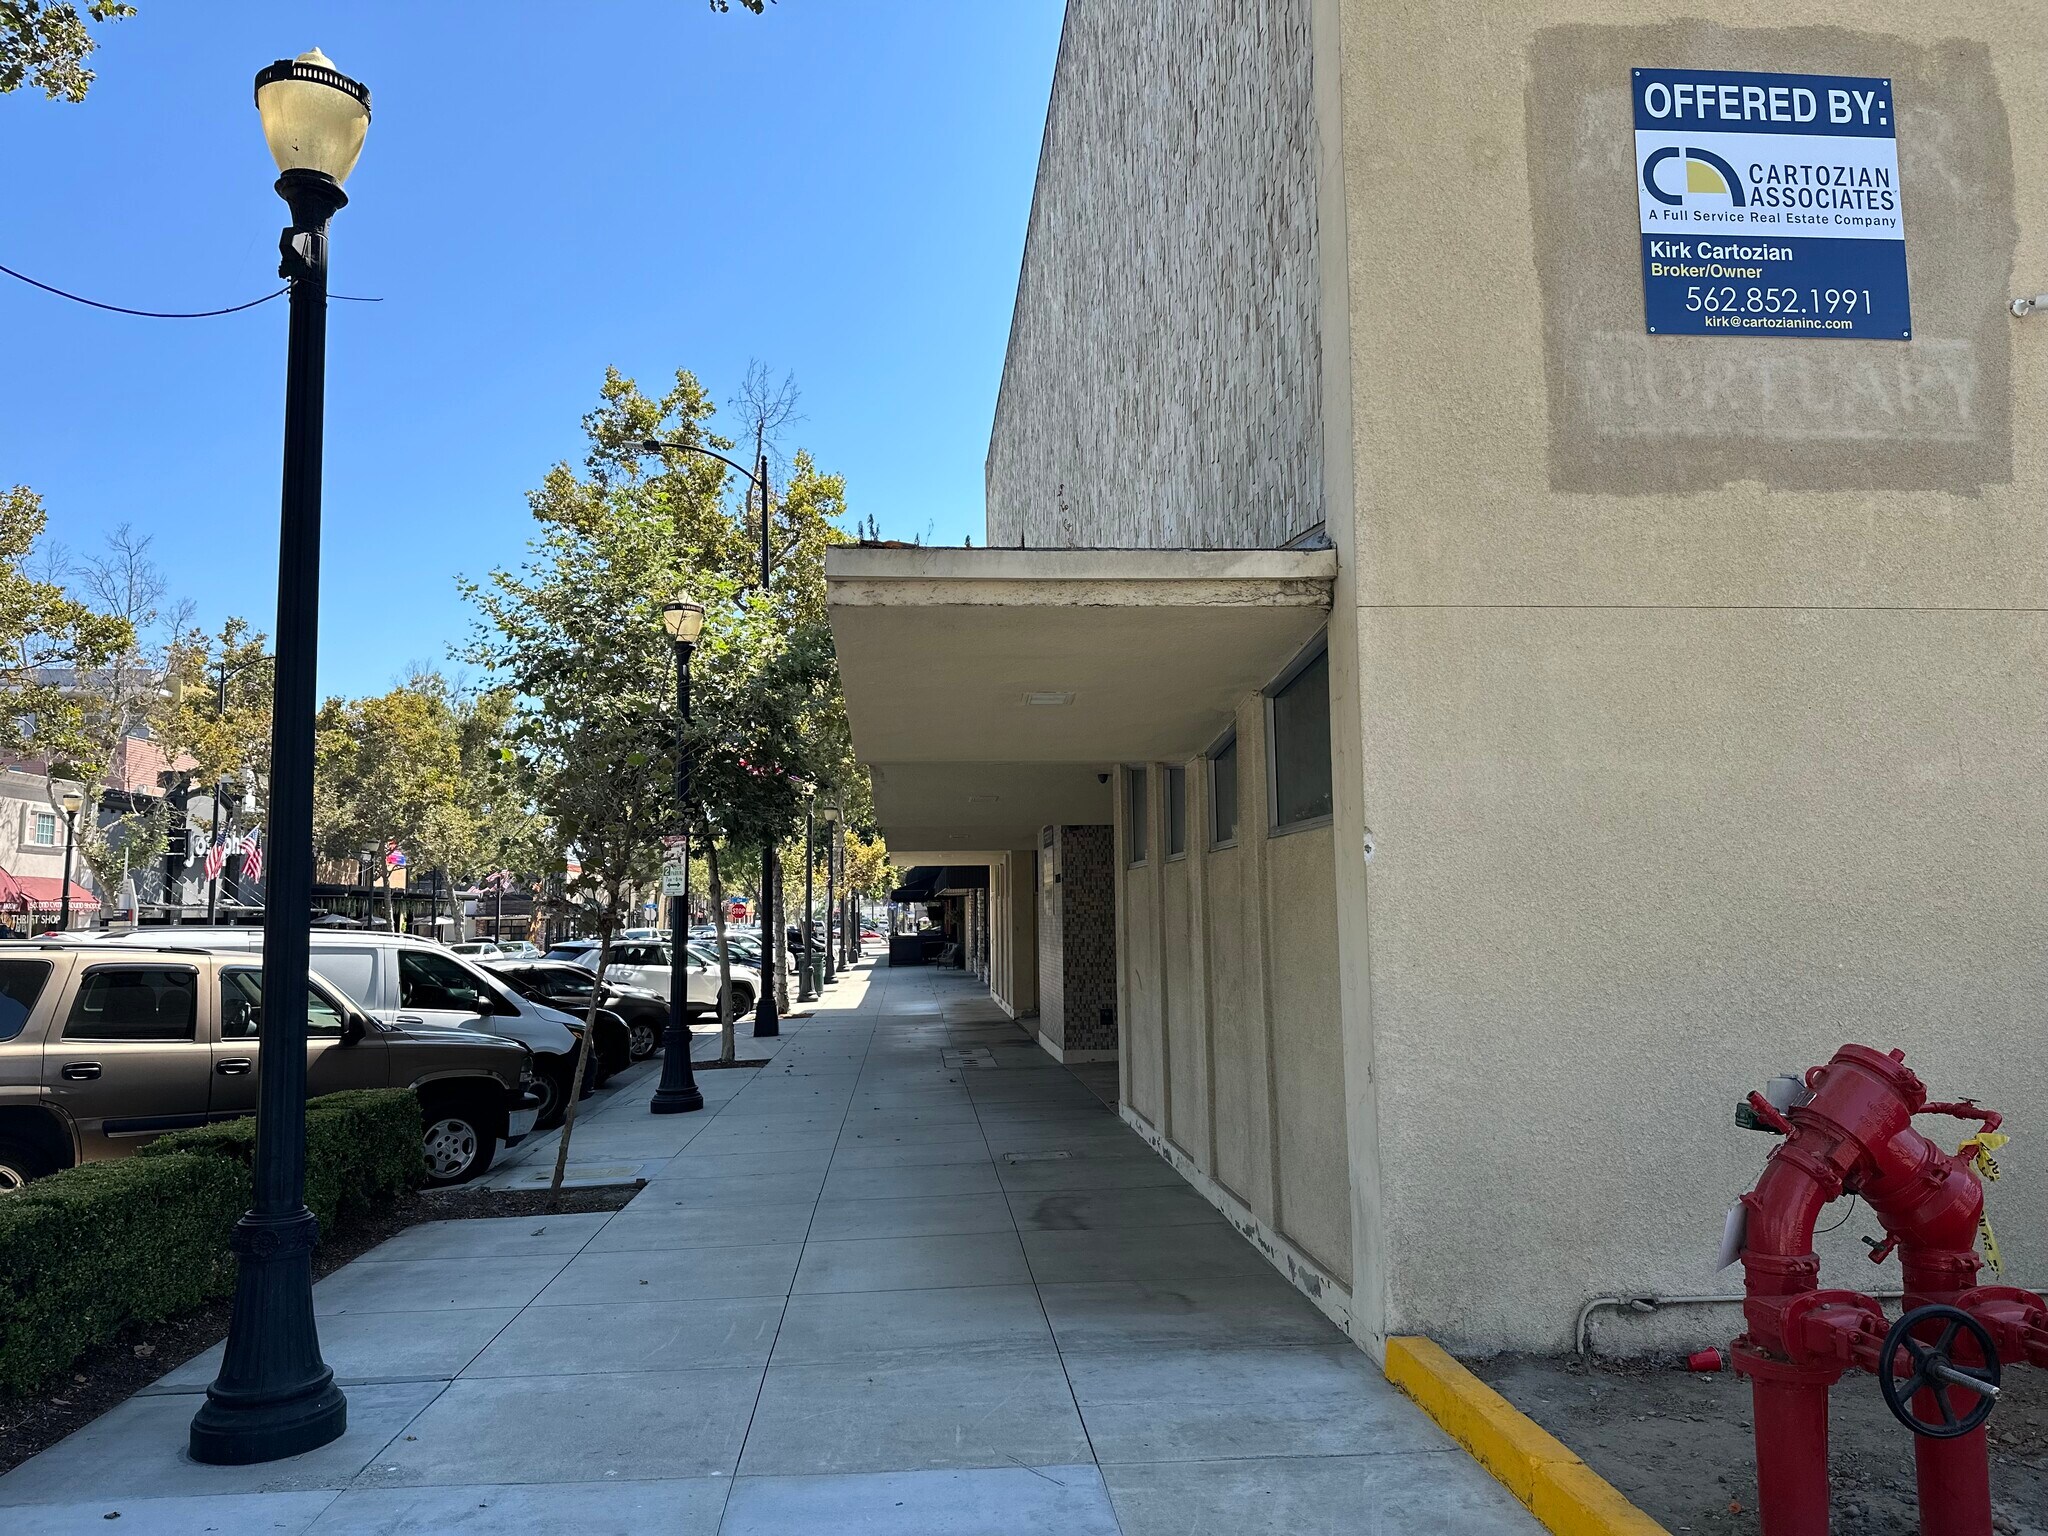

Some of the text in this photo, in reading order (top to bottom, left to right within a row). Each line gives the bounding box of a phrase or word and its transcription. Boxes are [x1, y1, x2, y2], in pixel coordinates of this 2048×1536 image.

[1644, 82, 1888, 126] OFFERED BY:
[1749, 163, 1890, 188] CARTOZIAN
[1750, 187, 1895, 211] ASSOCIATES
[1649, 209, 1897, 228] A Full Service Real Estate Company
[1650, 241, 1793, 261] Kirk Cartozian
[1651, 263, 1762, 278] Broker/Owner
[1685, 286, 1871, 315] 562.852.1991
[1705, 316, 1853, 330] kirk@cartozianinc.com
[40, 914, 61, 924] SHOP
